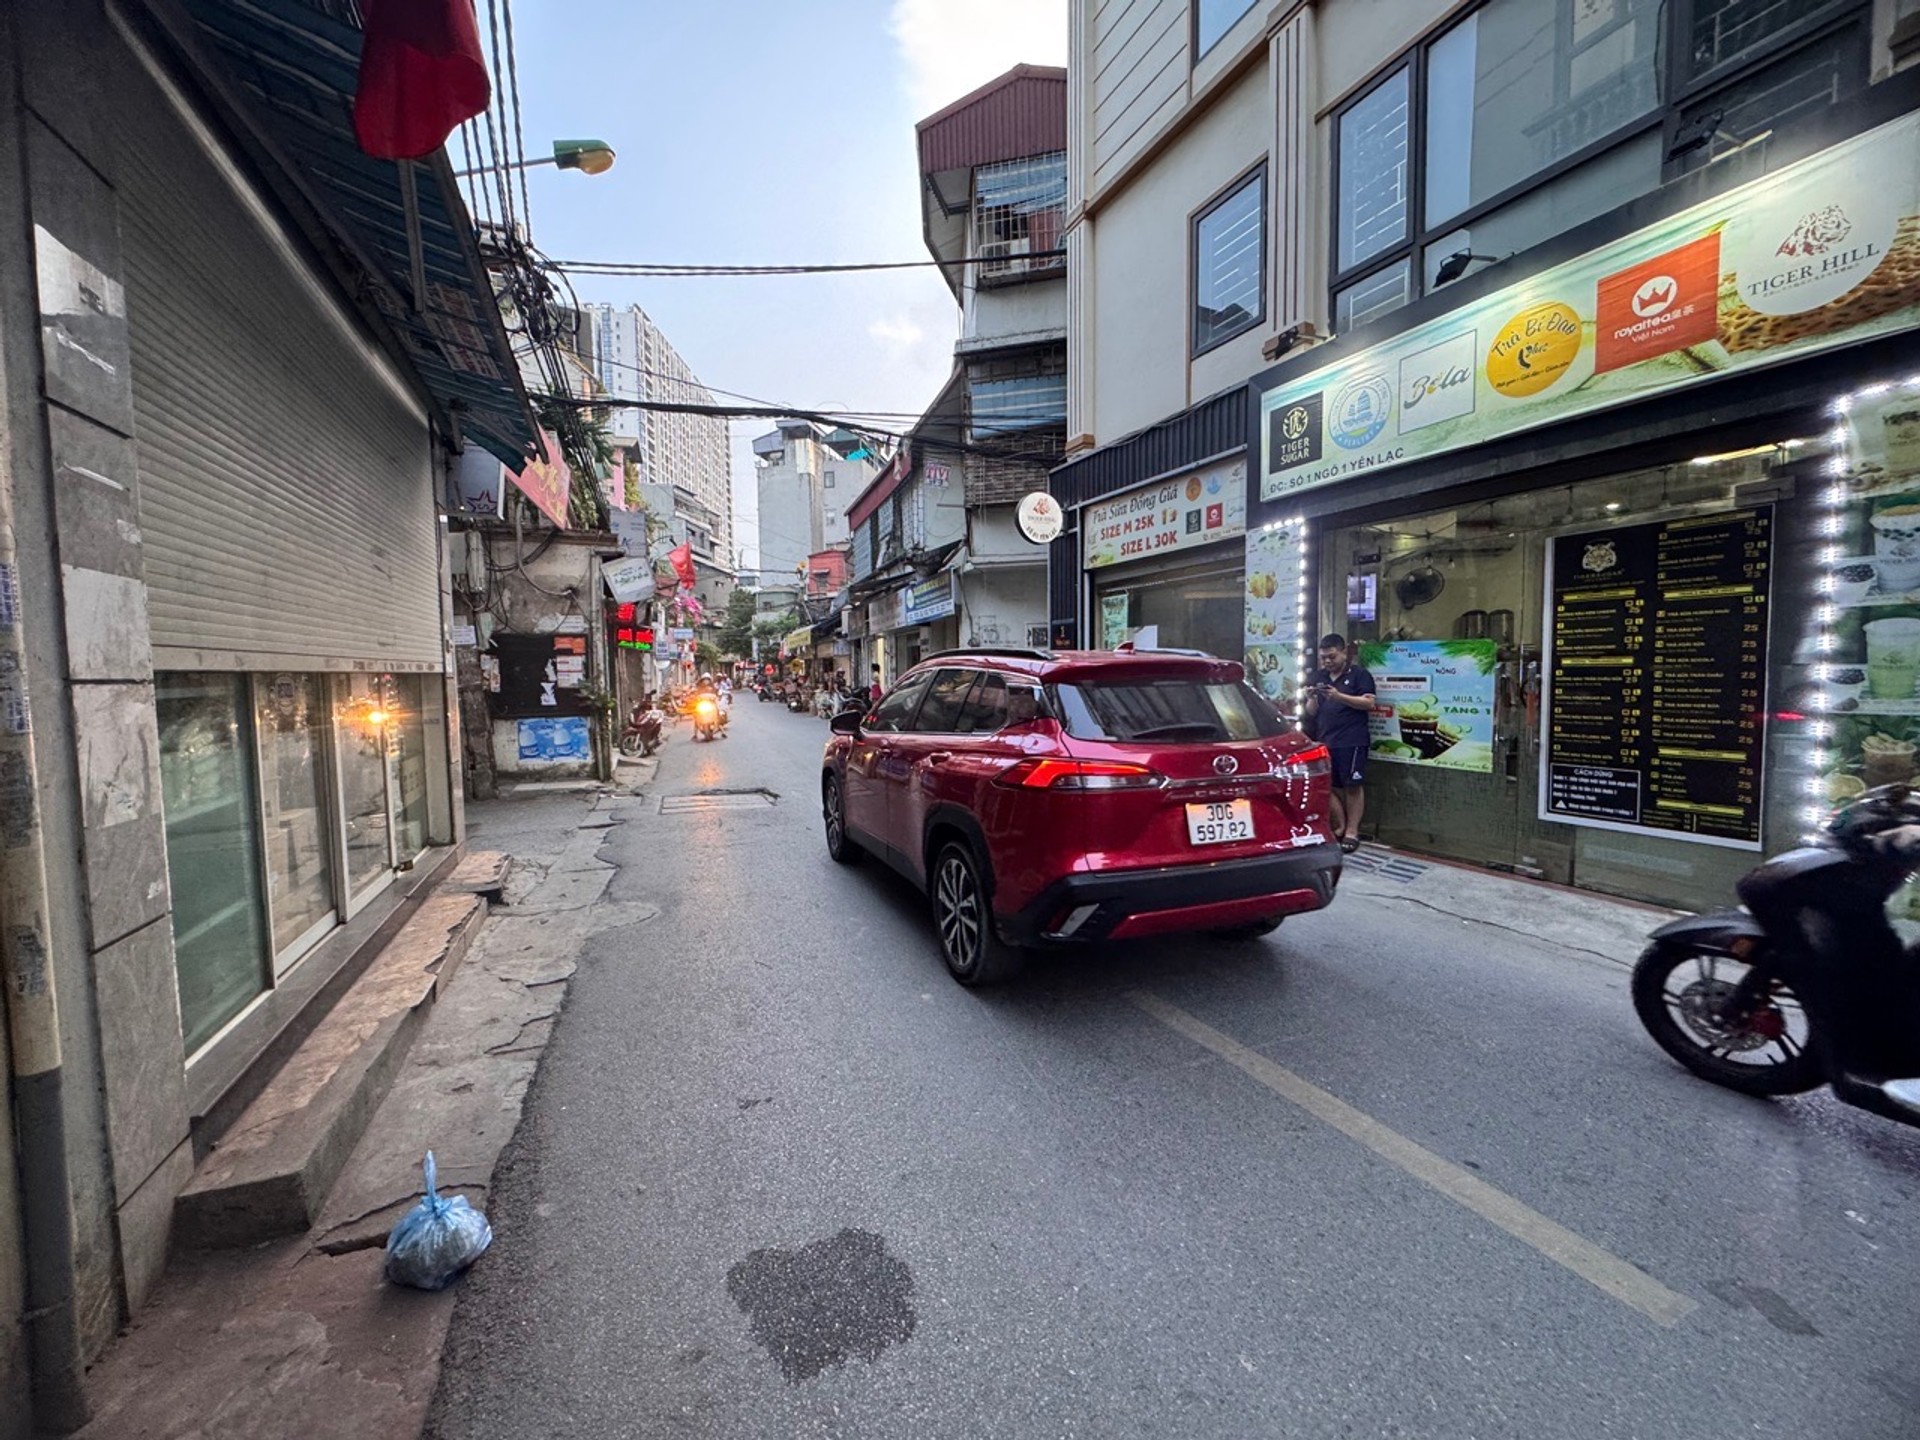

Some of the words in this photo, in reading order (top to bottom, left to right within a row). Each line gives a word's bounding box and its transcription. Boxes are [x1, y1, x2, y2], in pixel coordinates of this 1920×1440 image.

[1747, 265, 1813, 295] TIGER
[1822, 243, 1880, 271] HILL
[1614, 313, 1671, 340] royaltea
[1652, 324, 1676, 337] Nam
[1491, 330, 1521, 357] Trà
[1281, 437, 1310, 453] TIGER
[1281, 448, 1310, 465] SUGAR
[1270, 482, 1287, 493] ĐC:
[1306, 475, 1311, 483] 1
[1342, 463, 1347, 472] 1
[1101, 525, 1121, 541] SIZE
[1123, 522, 1133, 534] M
[1135, 514, 1155, 531] 25K
[1120, 538, 1143, 556] SIZE
[1145, 537, 1152, 550] L
[1154, 530, 1178, 548] 30K
[1744, 624, 1758, 632] 25
[1453, 695, 1473, 703] MUA
[1206, 804, 1233, 821] 30G
